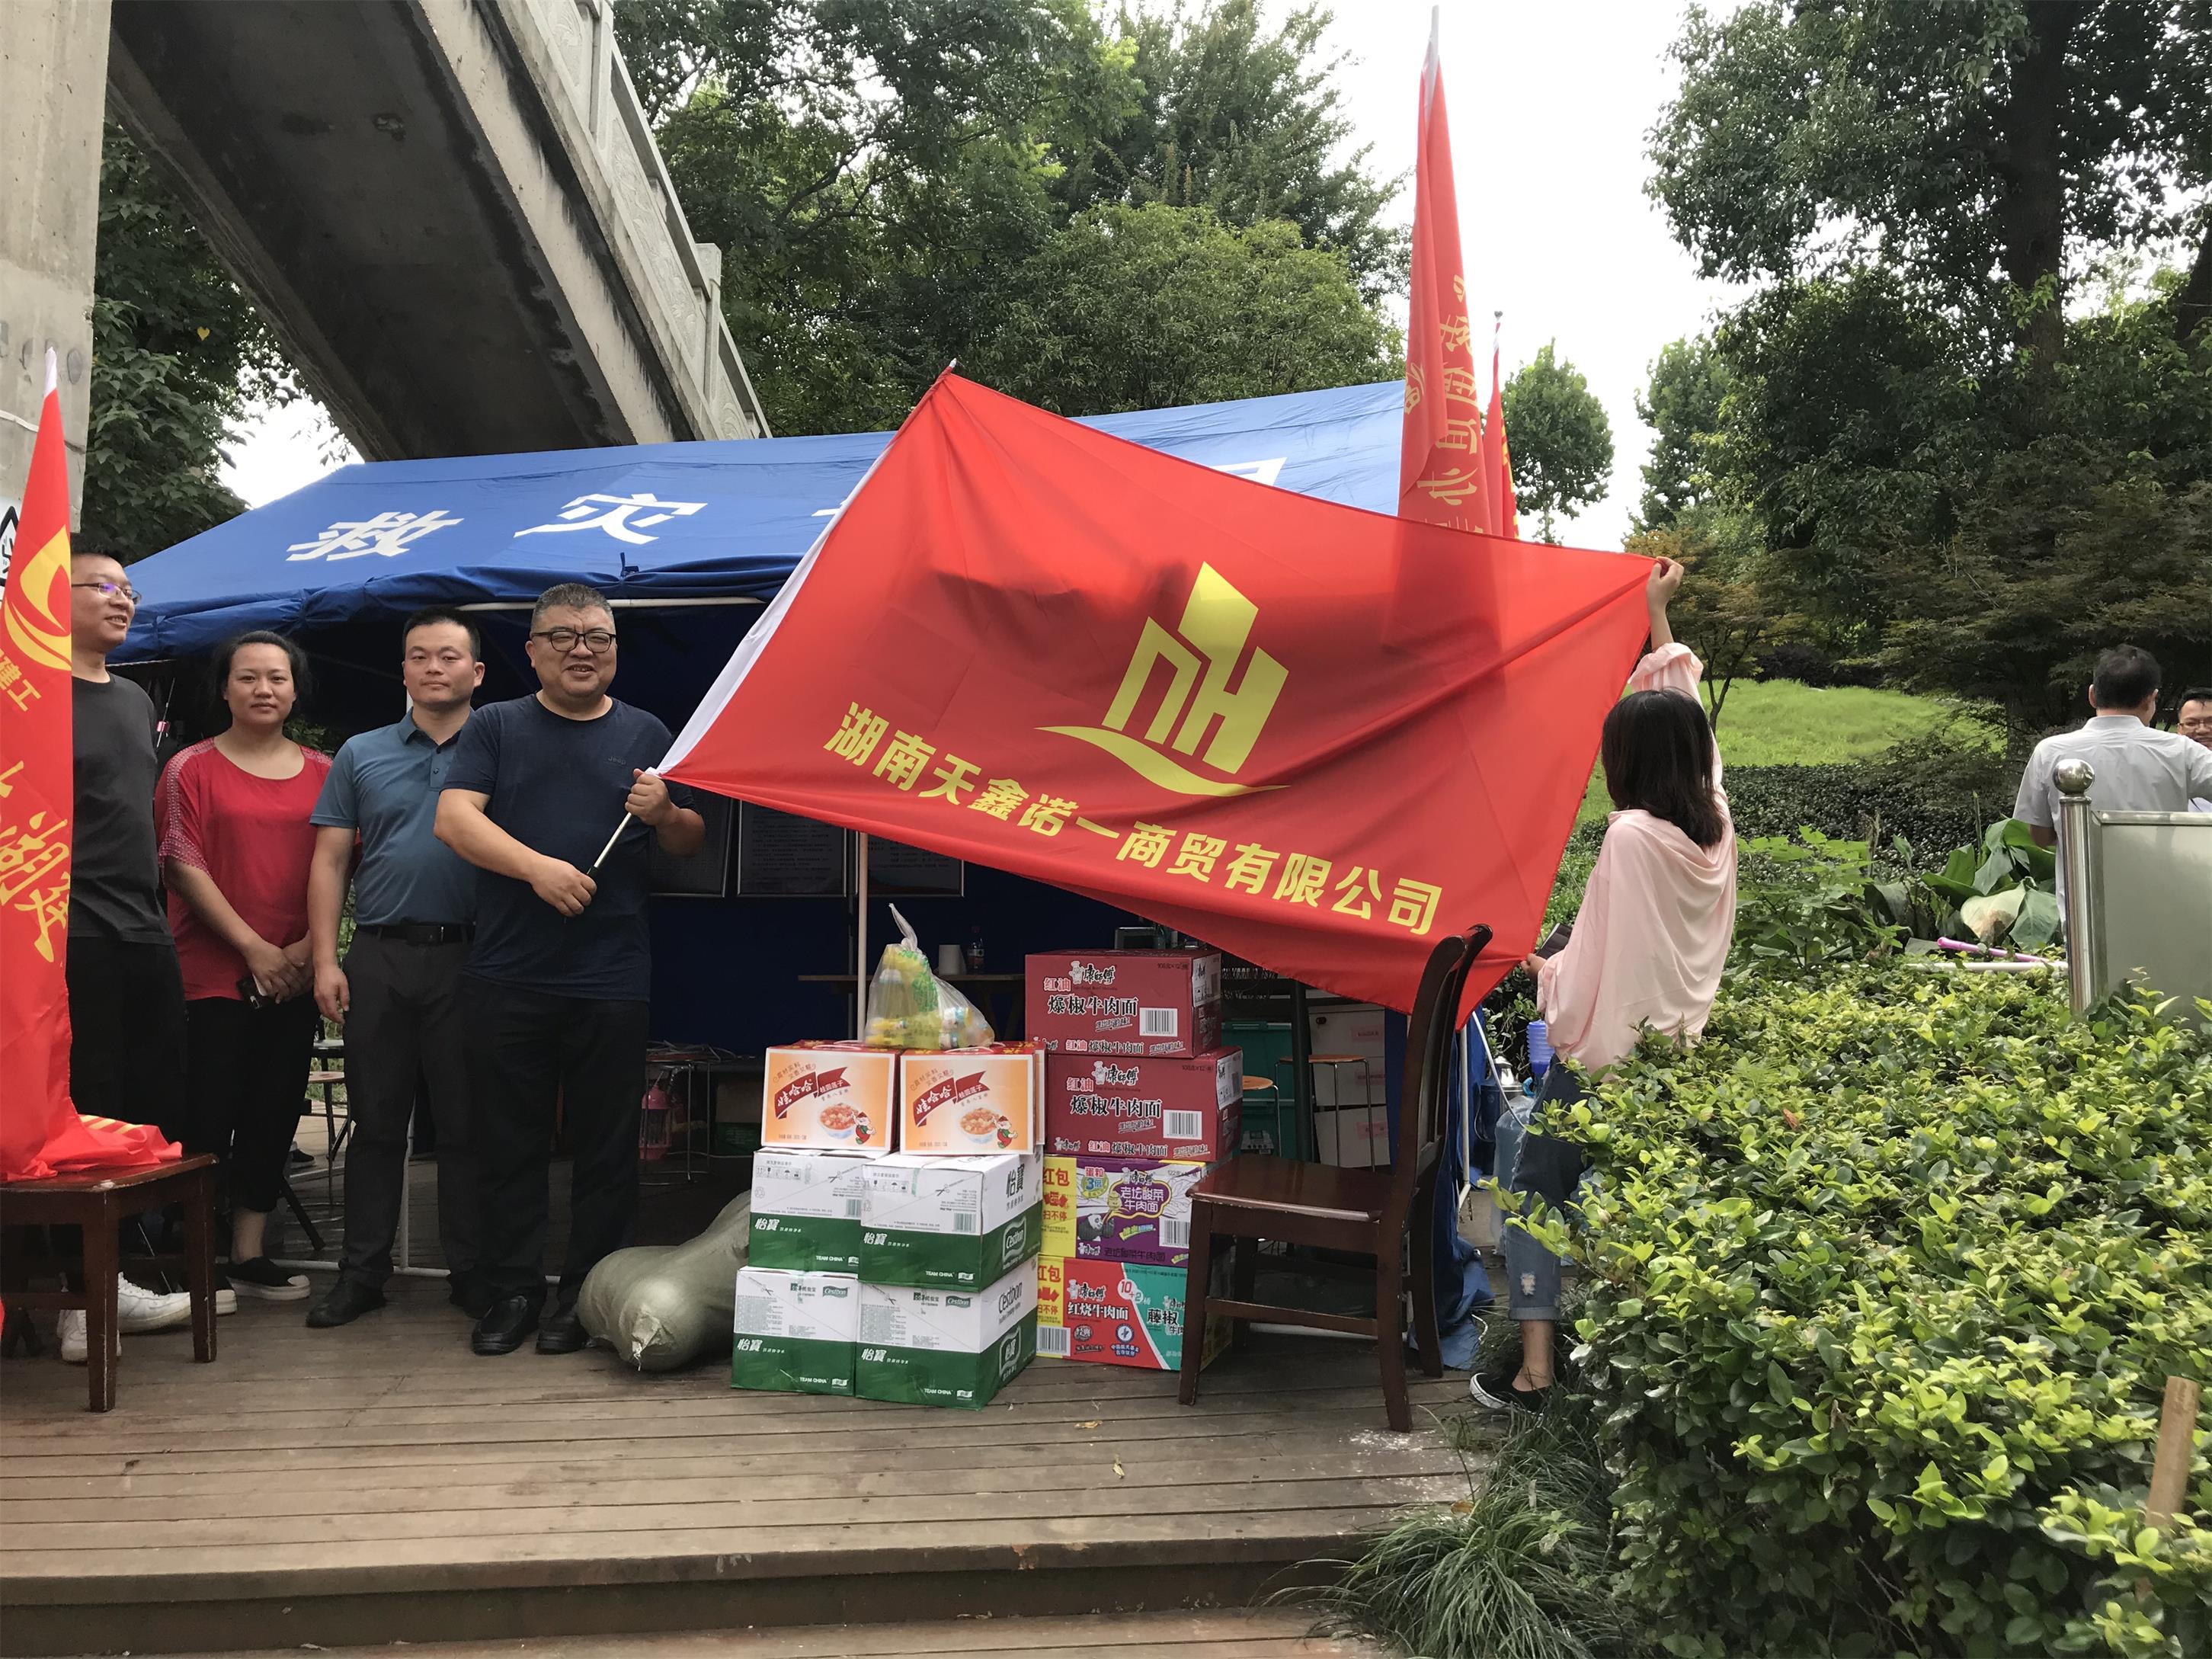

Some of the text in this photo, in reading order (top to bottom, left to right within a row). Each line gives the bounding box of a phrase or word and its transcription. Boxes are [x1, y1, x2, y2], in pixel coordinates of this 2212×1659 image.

[0, 652, 41, 712] 建工
[823, 700, 1443, 936] 湖南天鑫诺一商贸有限公司
[1043, 977, 1071, 991] 红油
[1048, 994, 1138, 1017] 爆椒牛肉面
[777, 1079, 814, 1107] 娃哈哈
[1066, 1077, 1094, 1092] 红油
[916, 1085, 952, 1115] 娃哈哈
[1070, 1096, 1162, 1118] 爆椒牛肉面
[1120, 1186, 1165, 1202] 老坛酸菜
[1124, 1201, 1159, 1212] 牛肉面
[1067, 1302, 1128, 1321] 红烧牛肉面
[1148, 1308, 1179, 1325] 藤椒
